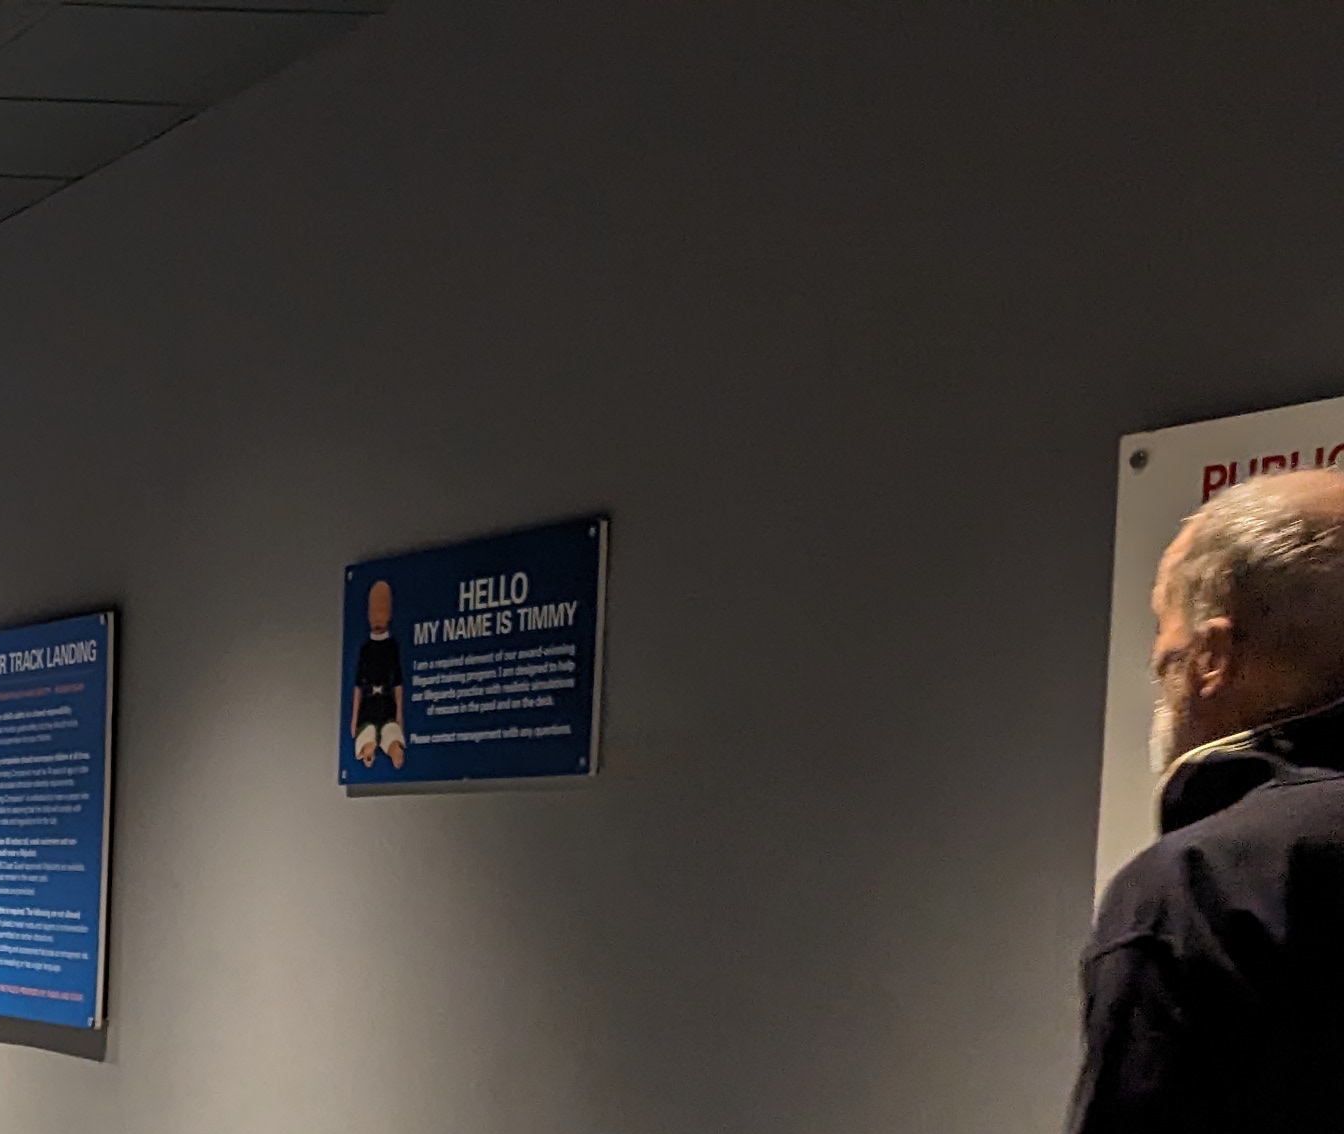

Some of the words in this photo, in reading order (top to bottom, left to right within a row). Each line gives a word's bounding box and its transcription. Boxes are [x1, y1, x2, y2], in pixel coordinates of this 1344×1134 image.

[459, 571, 529, 612] HELLO
[413, 620, 439, 646] MY
[443, 613, 492, 642] NAME
[496, 610, 512, 635] IS
[517, 600, 577, 632] TIMMY
[9, 648, 44, 673] TRACK
[46, 639, 97, 668] LANDING
